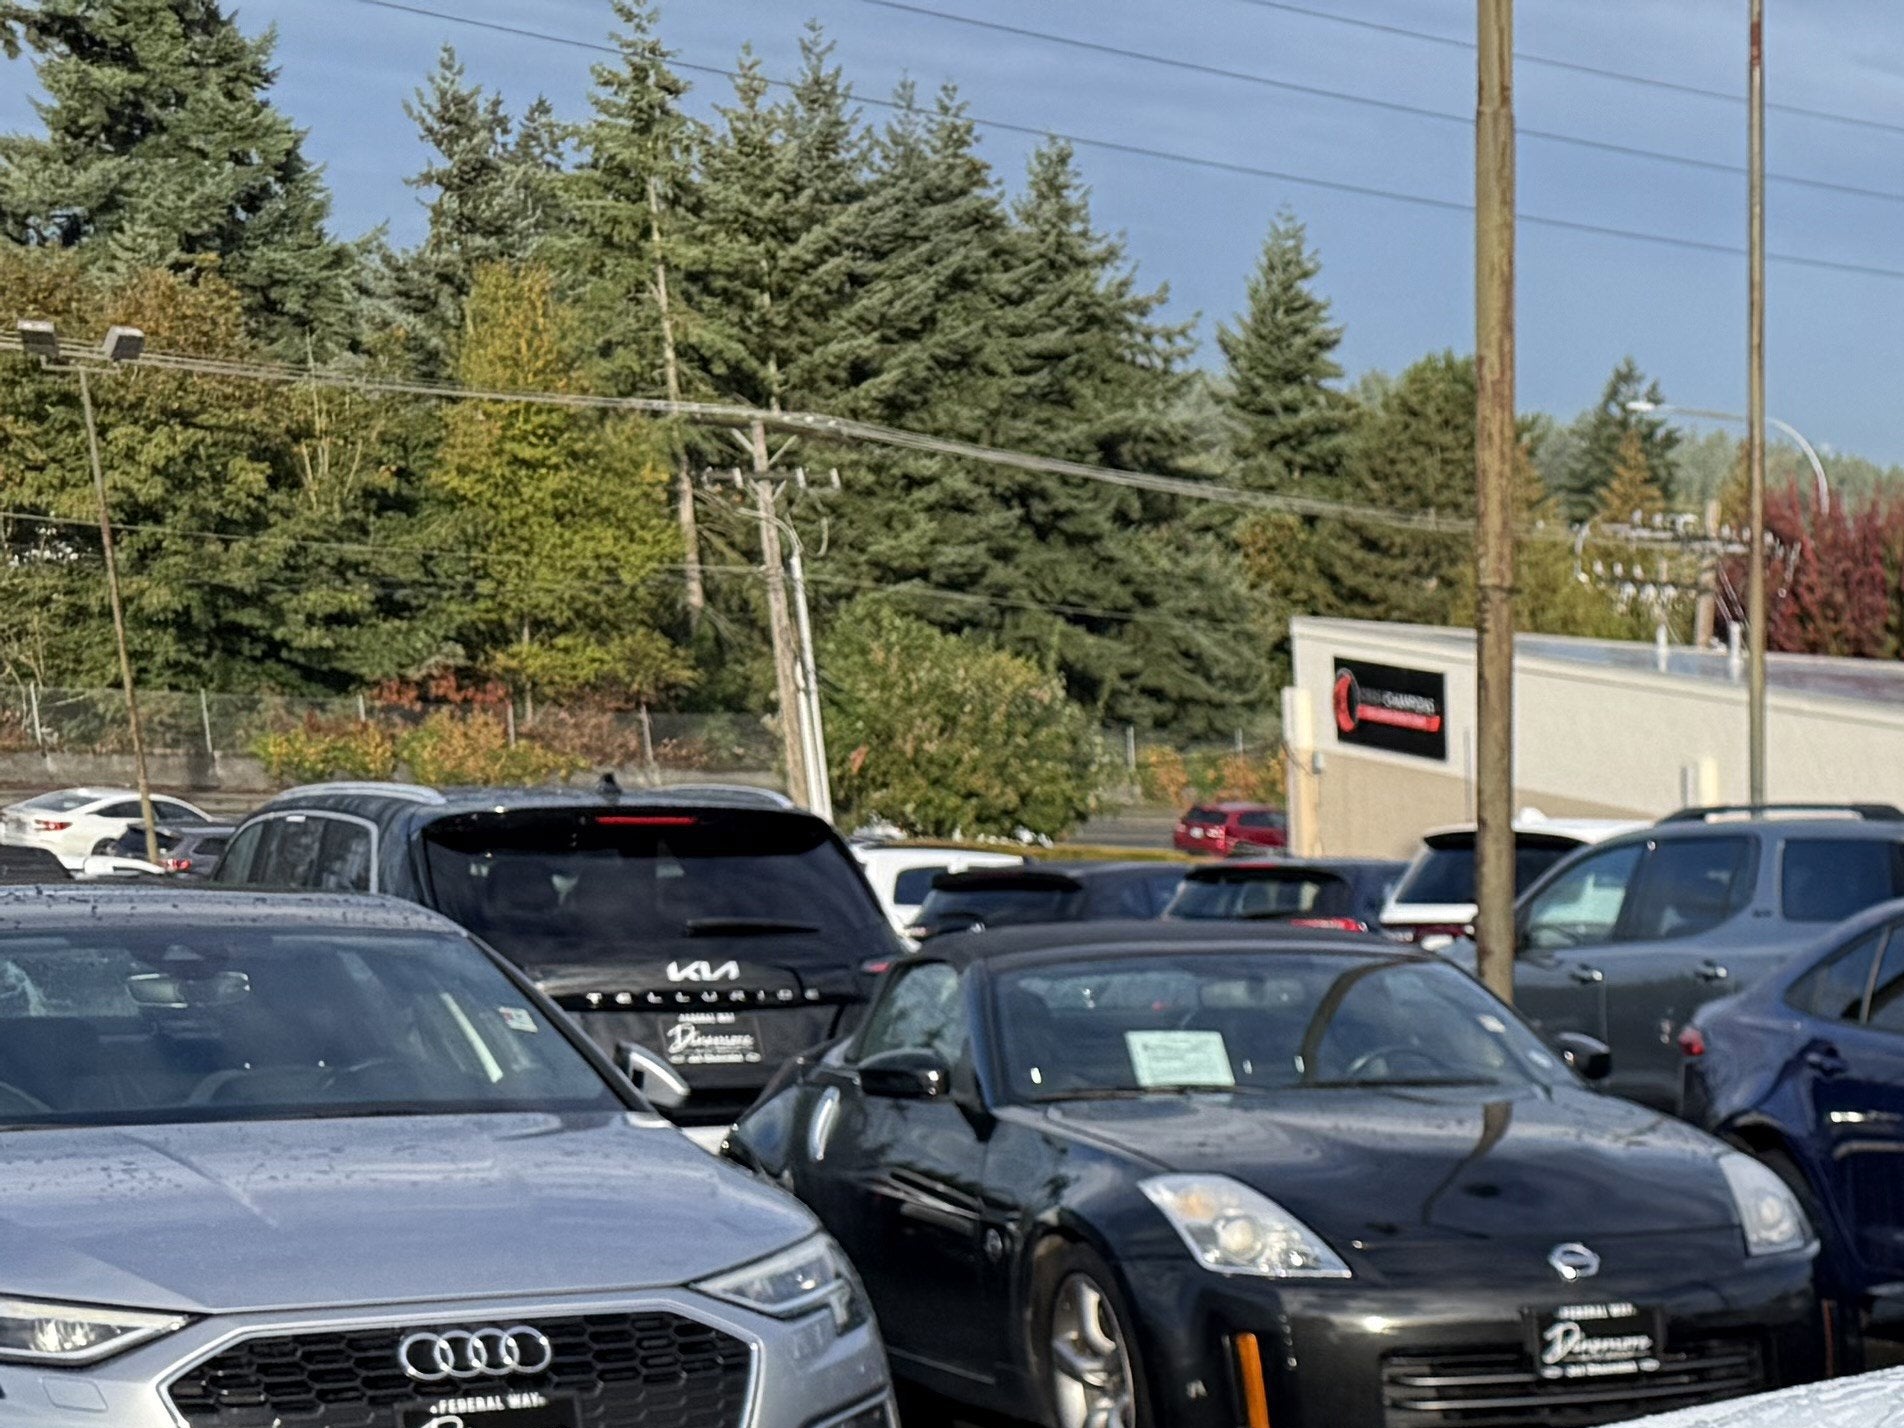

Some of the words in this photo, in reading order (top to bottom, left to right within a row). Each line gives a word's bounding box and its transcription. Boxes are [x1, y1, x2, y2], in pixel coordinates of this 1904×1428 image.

[586, 988, 819, 1006] TELLURIDE
[439, 1396, 505, 1413] FEDERAL
[506, 1391, 541, 1409] WAY
